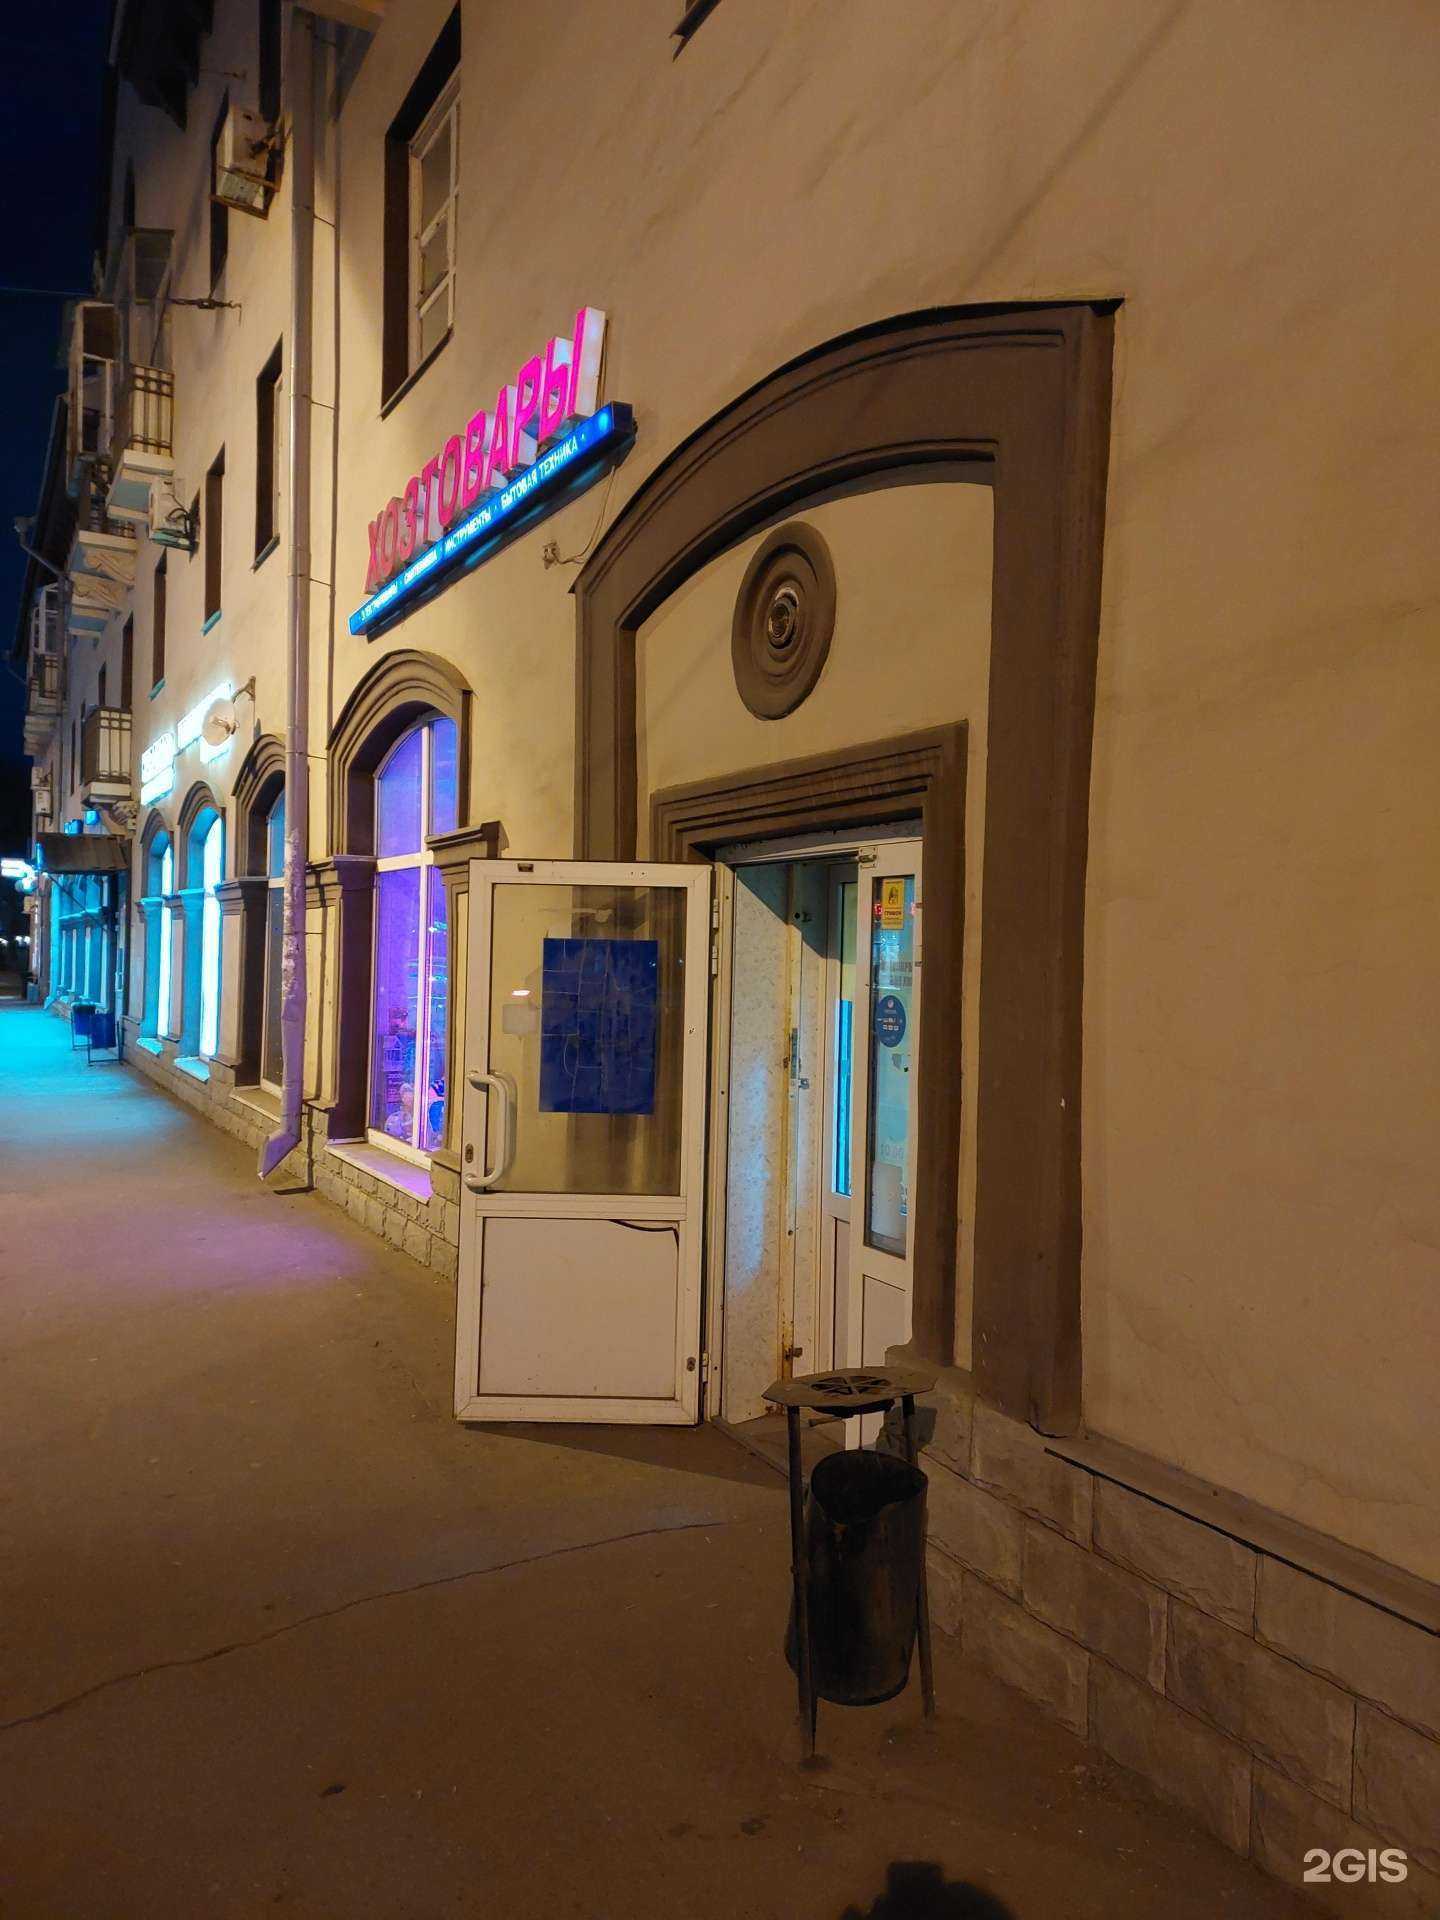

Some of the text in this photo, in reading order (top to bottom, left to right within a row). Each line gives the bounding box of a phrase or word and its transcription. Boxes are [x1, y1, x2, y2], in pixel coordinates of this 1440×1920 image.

[364, 305, 605, 595] ХОЗТОВАРЫ
[500, 468, 538, 510] БЫТОВАЯ
[538, 435, 578, 480] ТЕХНИКА
